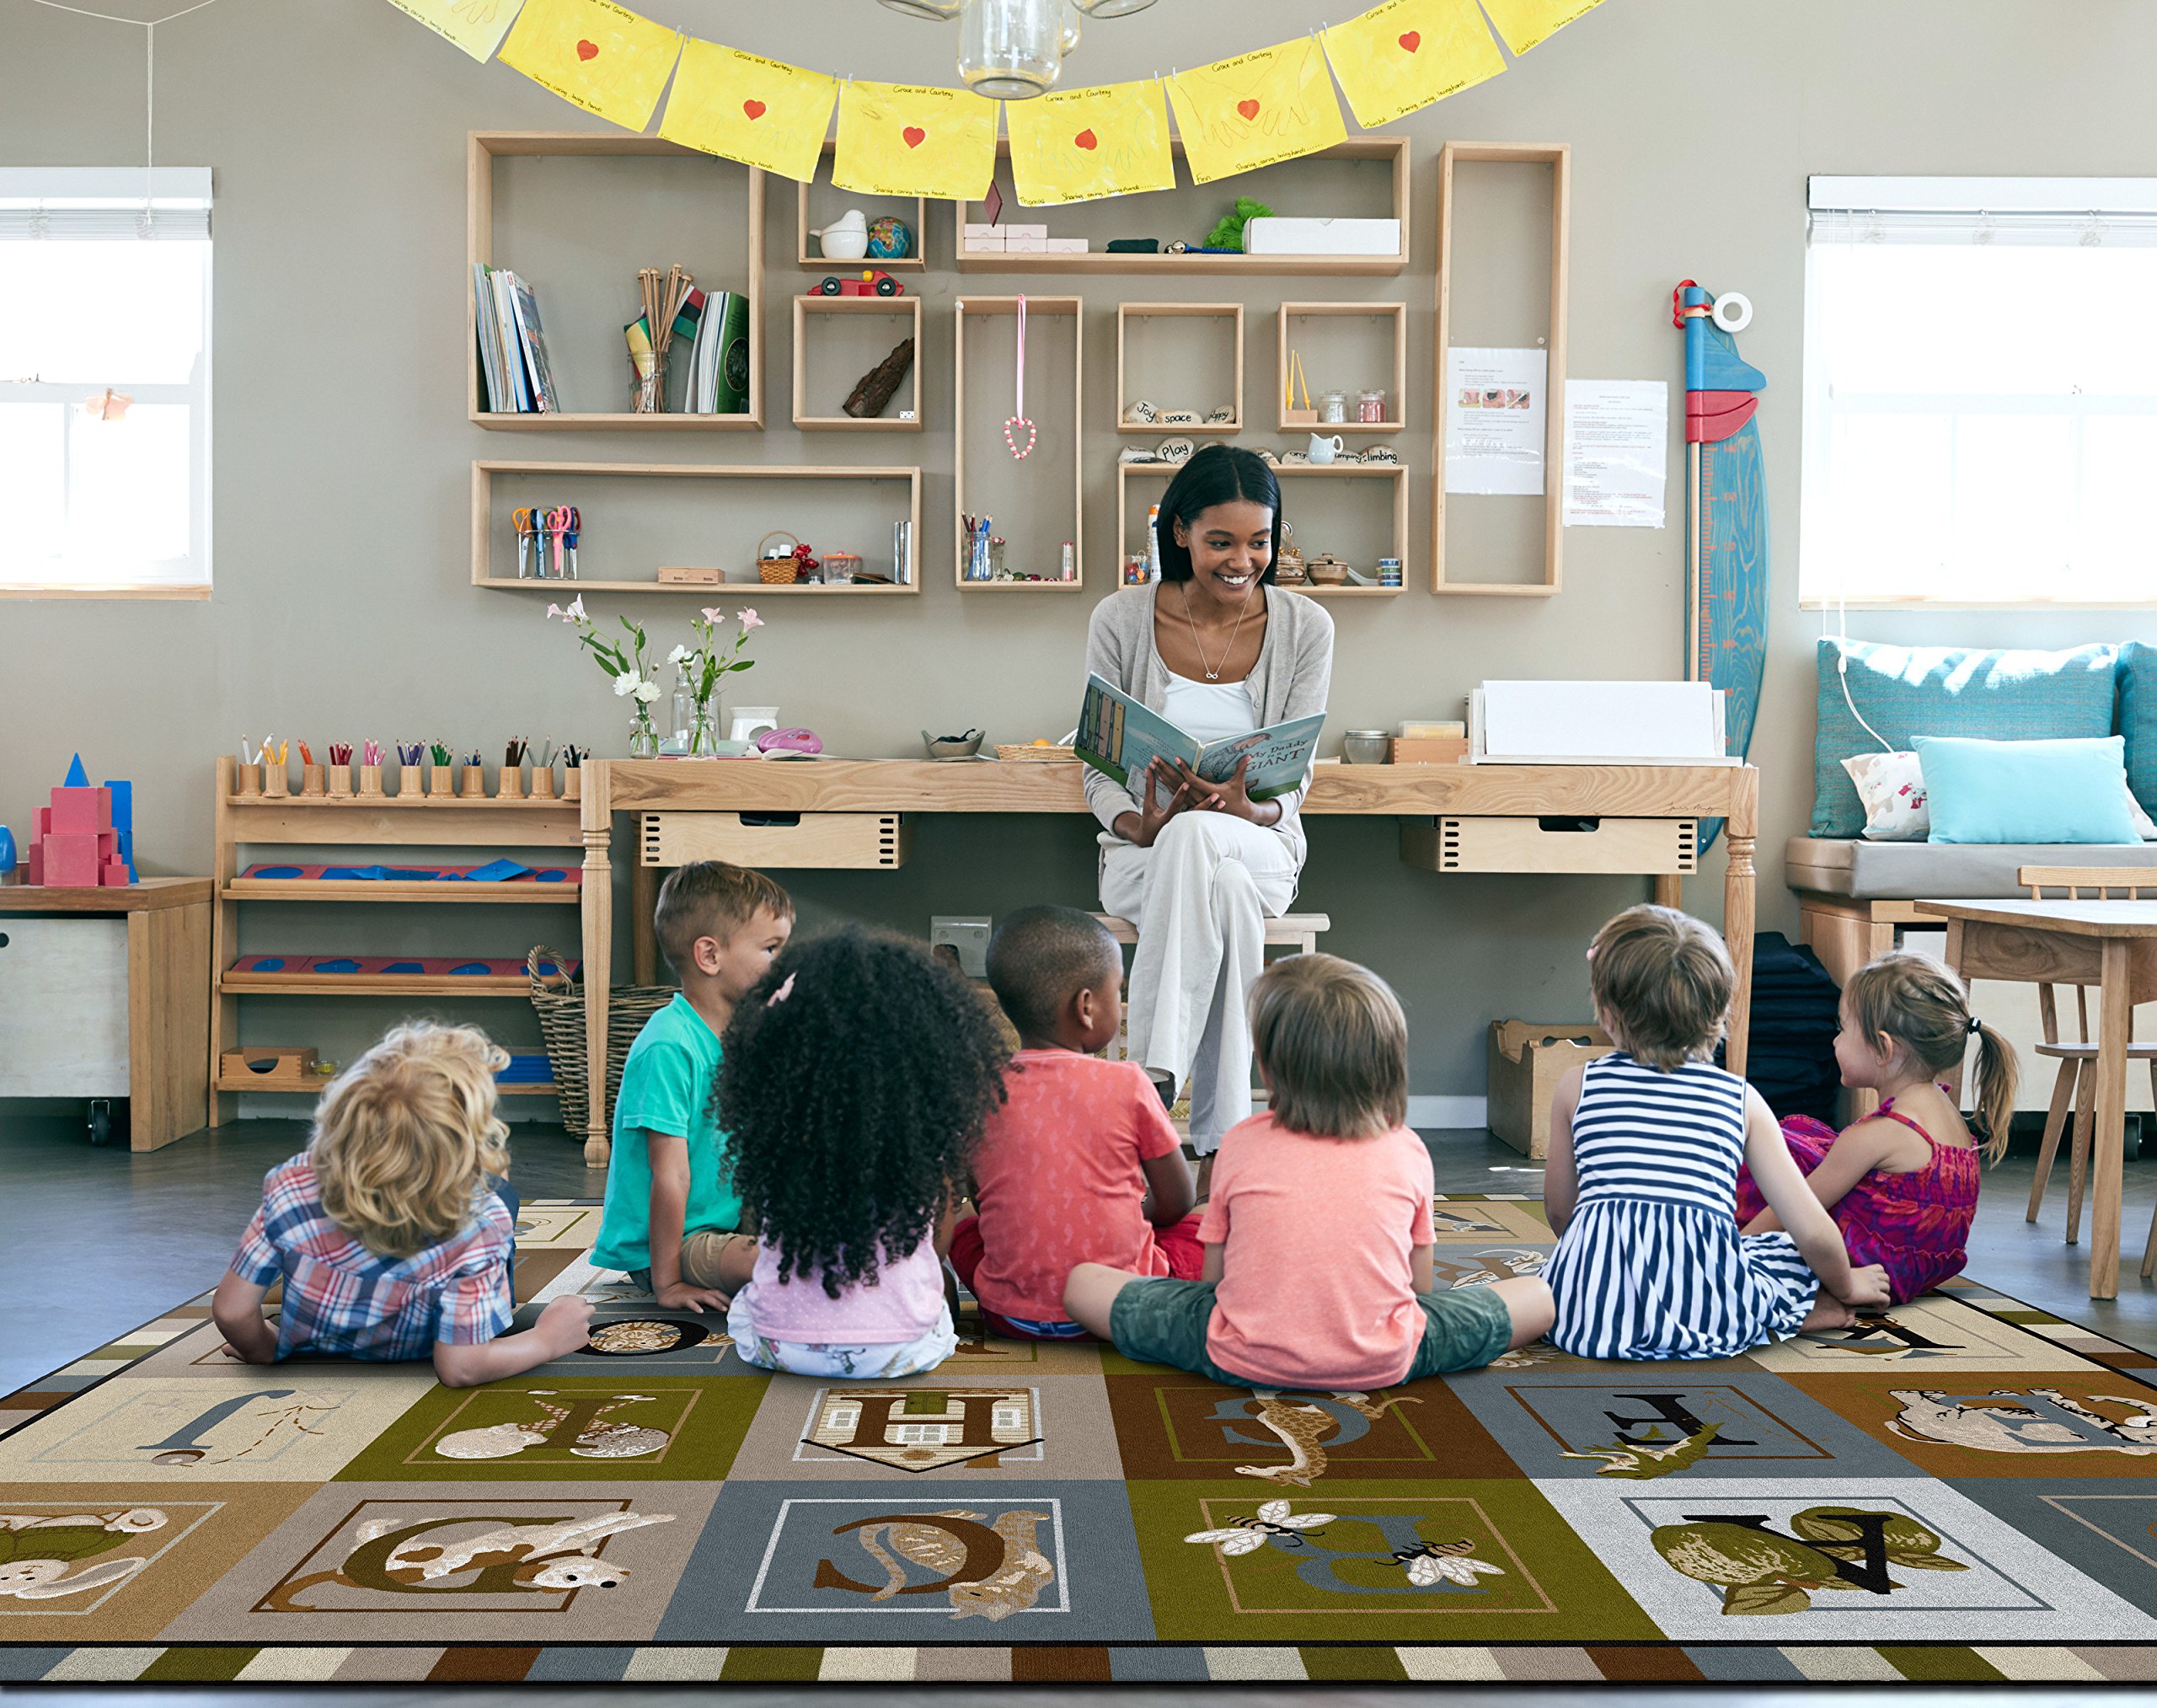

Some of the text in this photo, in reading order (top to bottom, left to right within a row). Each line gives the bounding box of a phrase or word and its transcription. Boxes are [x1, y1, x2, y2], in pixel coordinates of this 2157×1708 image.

[734, 51, 752, 61] Grace
[1212, 63, 1230, 72] Grace
[1046, 93, 1064, 102] Grace
[1196, 174, 1211, 185] Finn
[1019, 196, 1046, 206] Thomas
[1137, 402, 1156, 423] Joy
[1164, 414, 1191, 423] space
[1271, 740, 1308, 753] Daddy
[1245, 747, 1305, 772] GIANT
